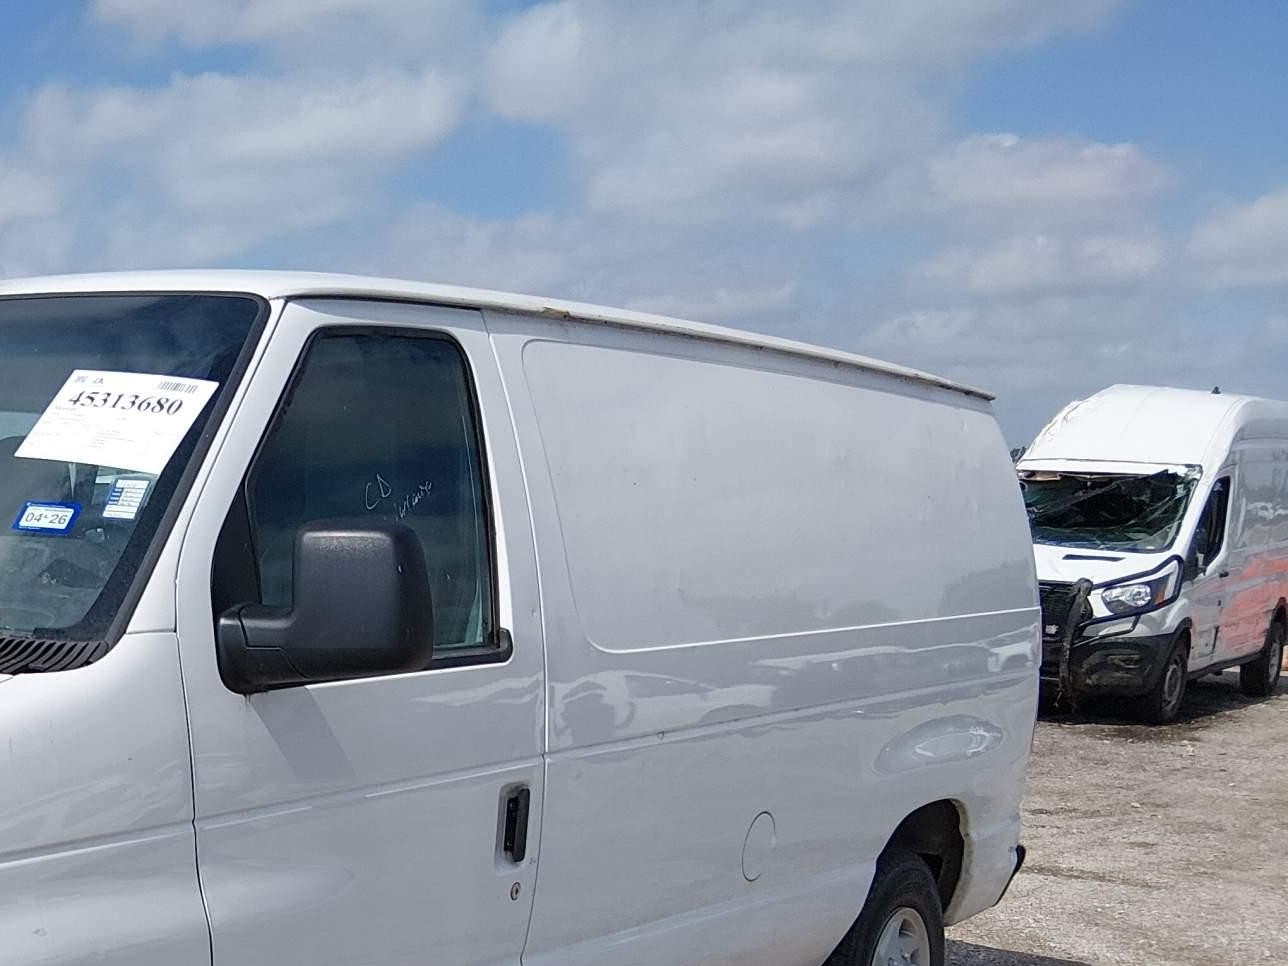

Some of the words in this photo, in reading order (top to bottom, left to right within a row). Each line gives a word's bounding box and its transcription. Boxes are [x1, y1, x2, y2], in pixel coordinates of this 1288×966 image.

[68, 390, 183, 415] 45313680
[25, 512, 42, 523] 04
[48, 513, 68, 524] 26
